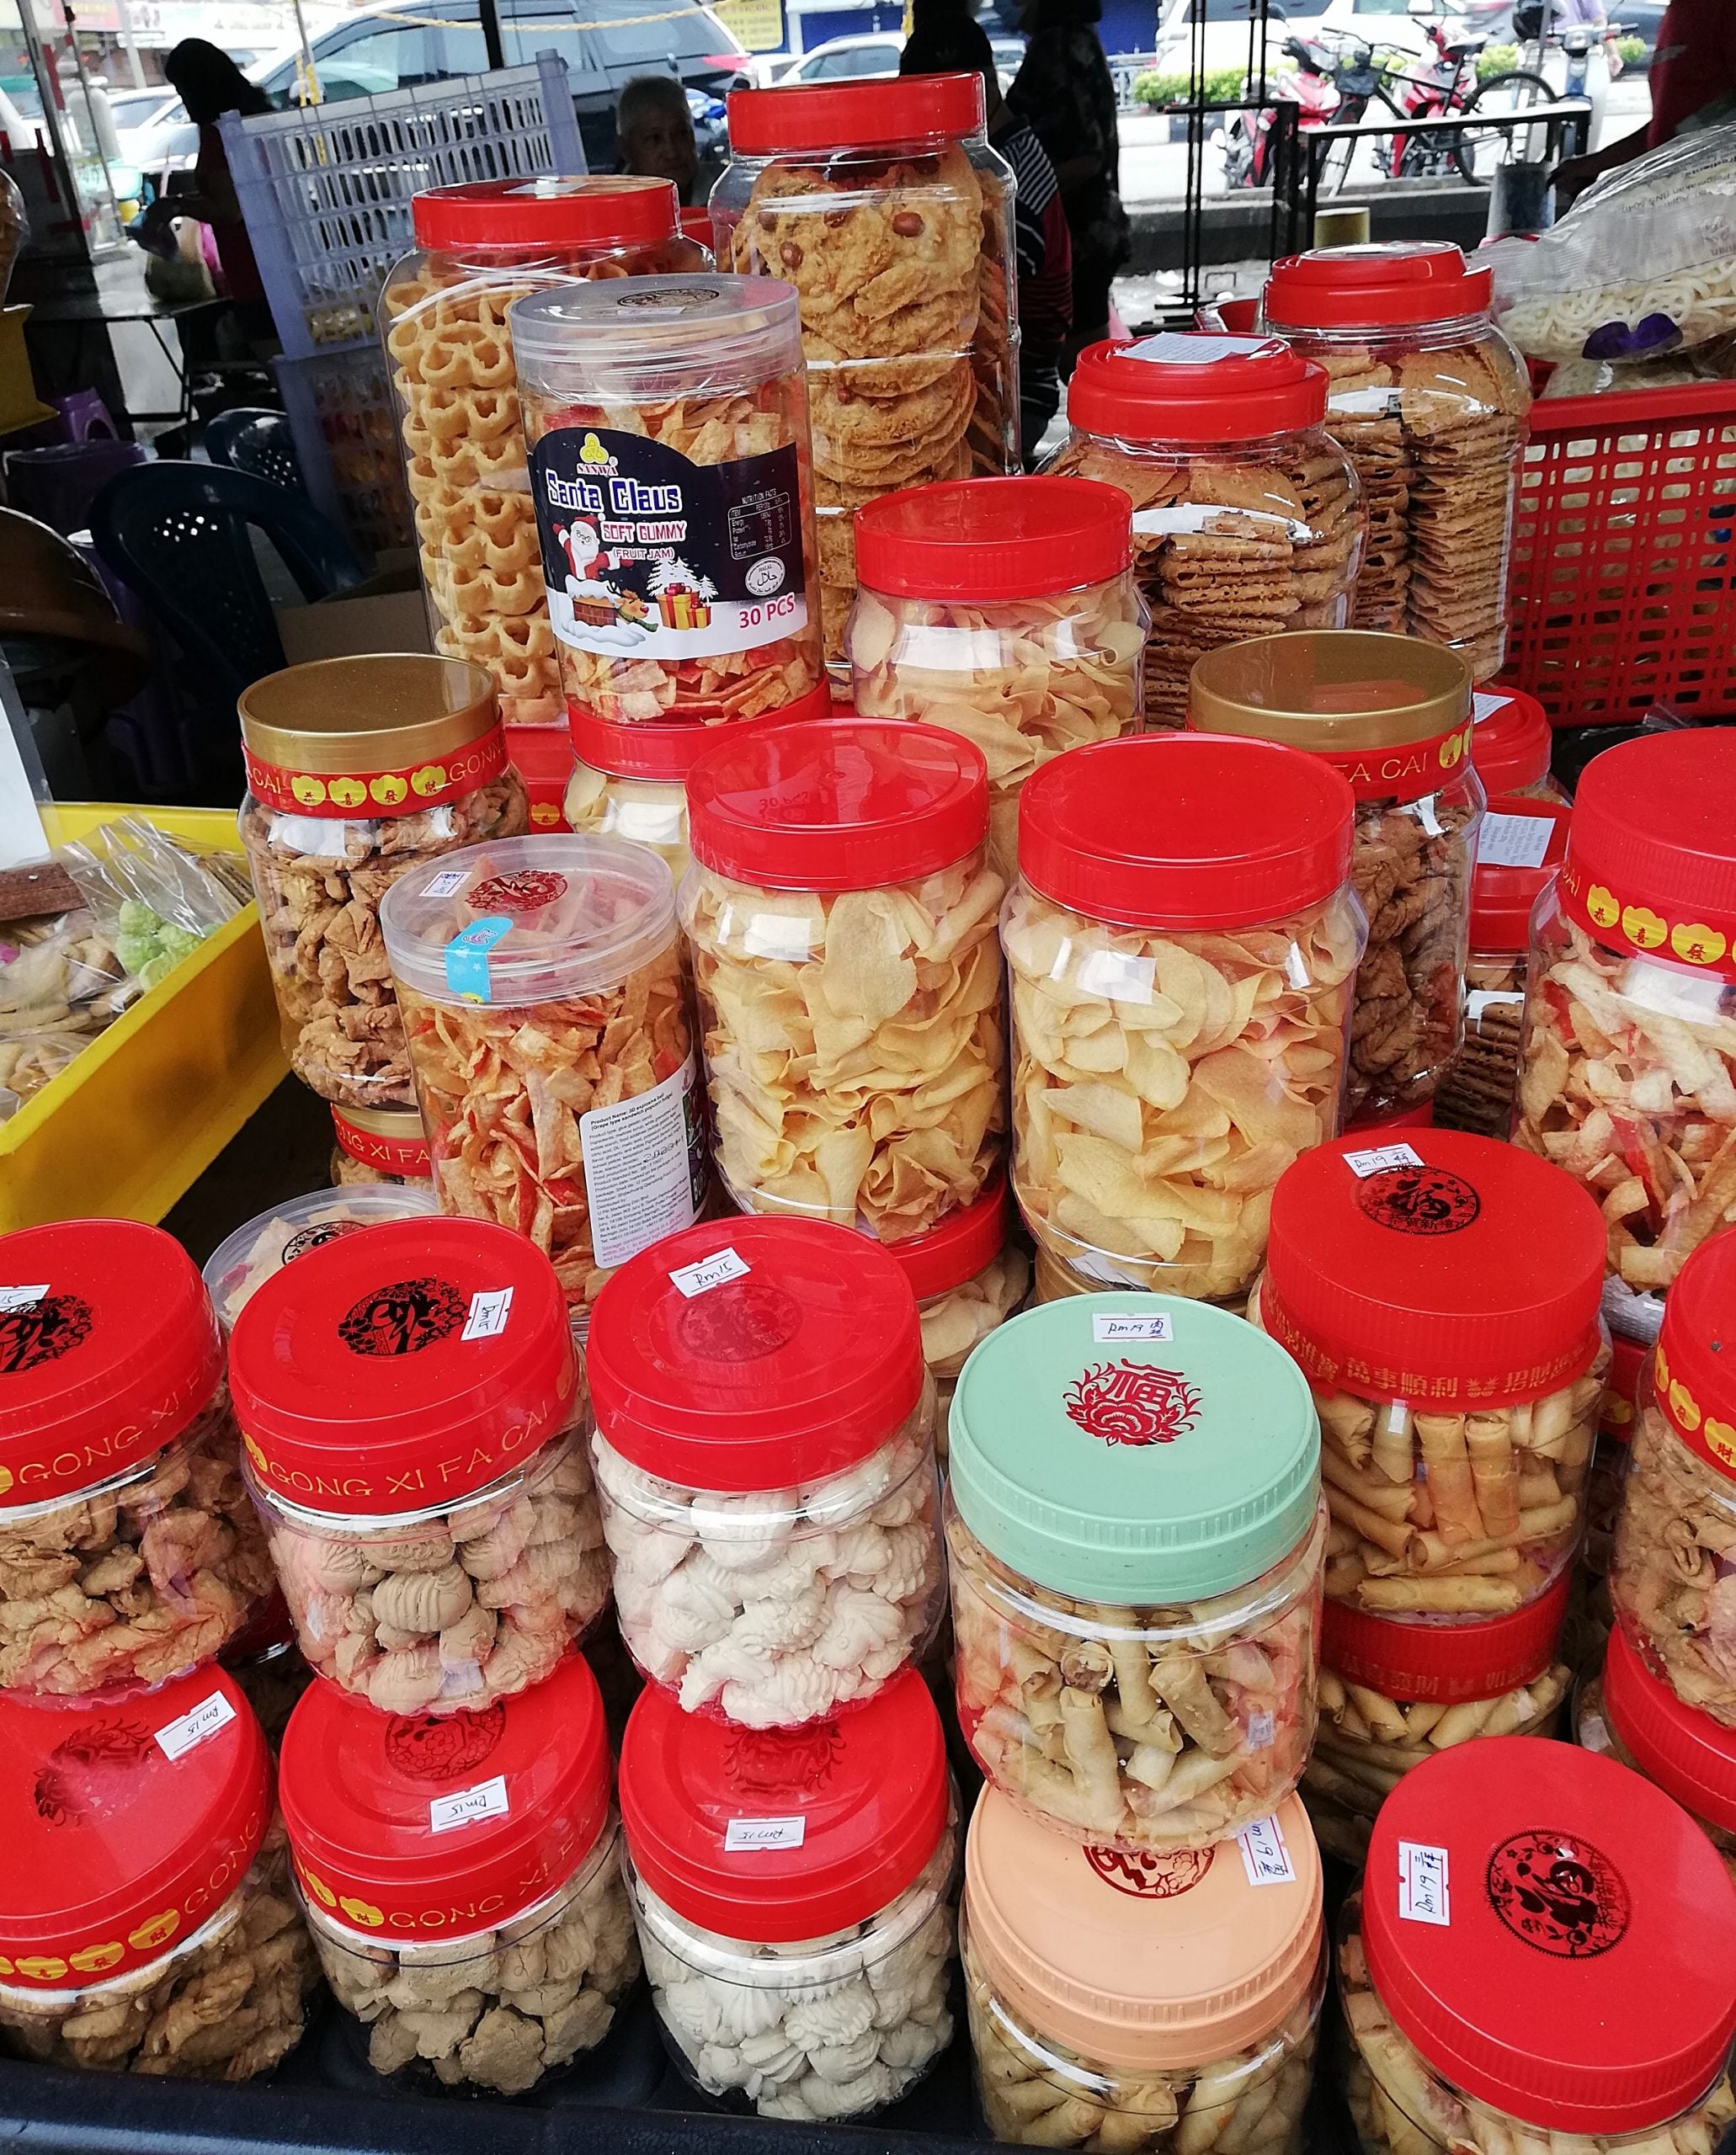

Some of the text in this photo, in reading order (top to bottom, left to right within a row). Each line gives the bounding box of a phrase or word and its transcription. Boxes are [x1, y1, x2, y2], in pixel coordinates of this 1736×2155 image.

[577, 464, 618, 476] SANWA
[546, 469, 682, 514] Santa Claus
[601, 520, 687, 543] SOFT GUMMY
[613, 547, 674, 561] (FRUIT JAM)
[739, 593, 796, 629] 30 PCS
[1381, 752, 1427, 780] CAI
[370, 1141, 391, 1161] XI
[1347, 1356, 1459, 1398] 萬事順利
[19, 1425, 142, 1484] GONG
[152, 1391, 179, 1430] XI
[269, 1399, 548, 1497] GONG XI FA CAI
[184, 1812, 260, 1915] GONG
[389, 1894, 505, 1929] GONG
[519, 1861, 549, 1897] XI
